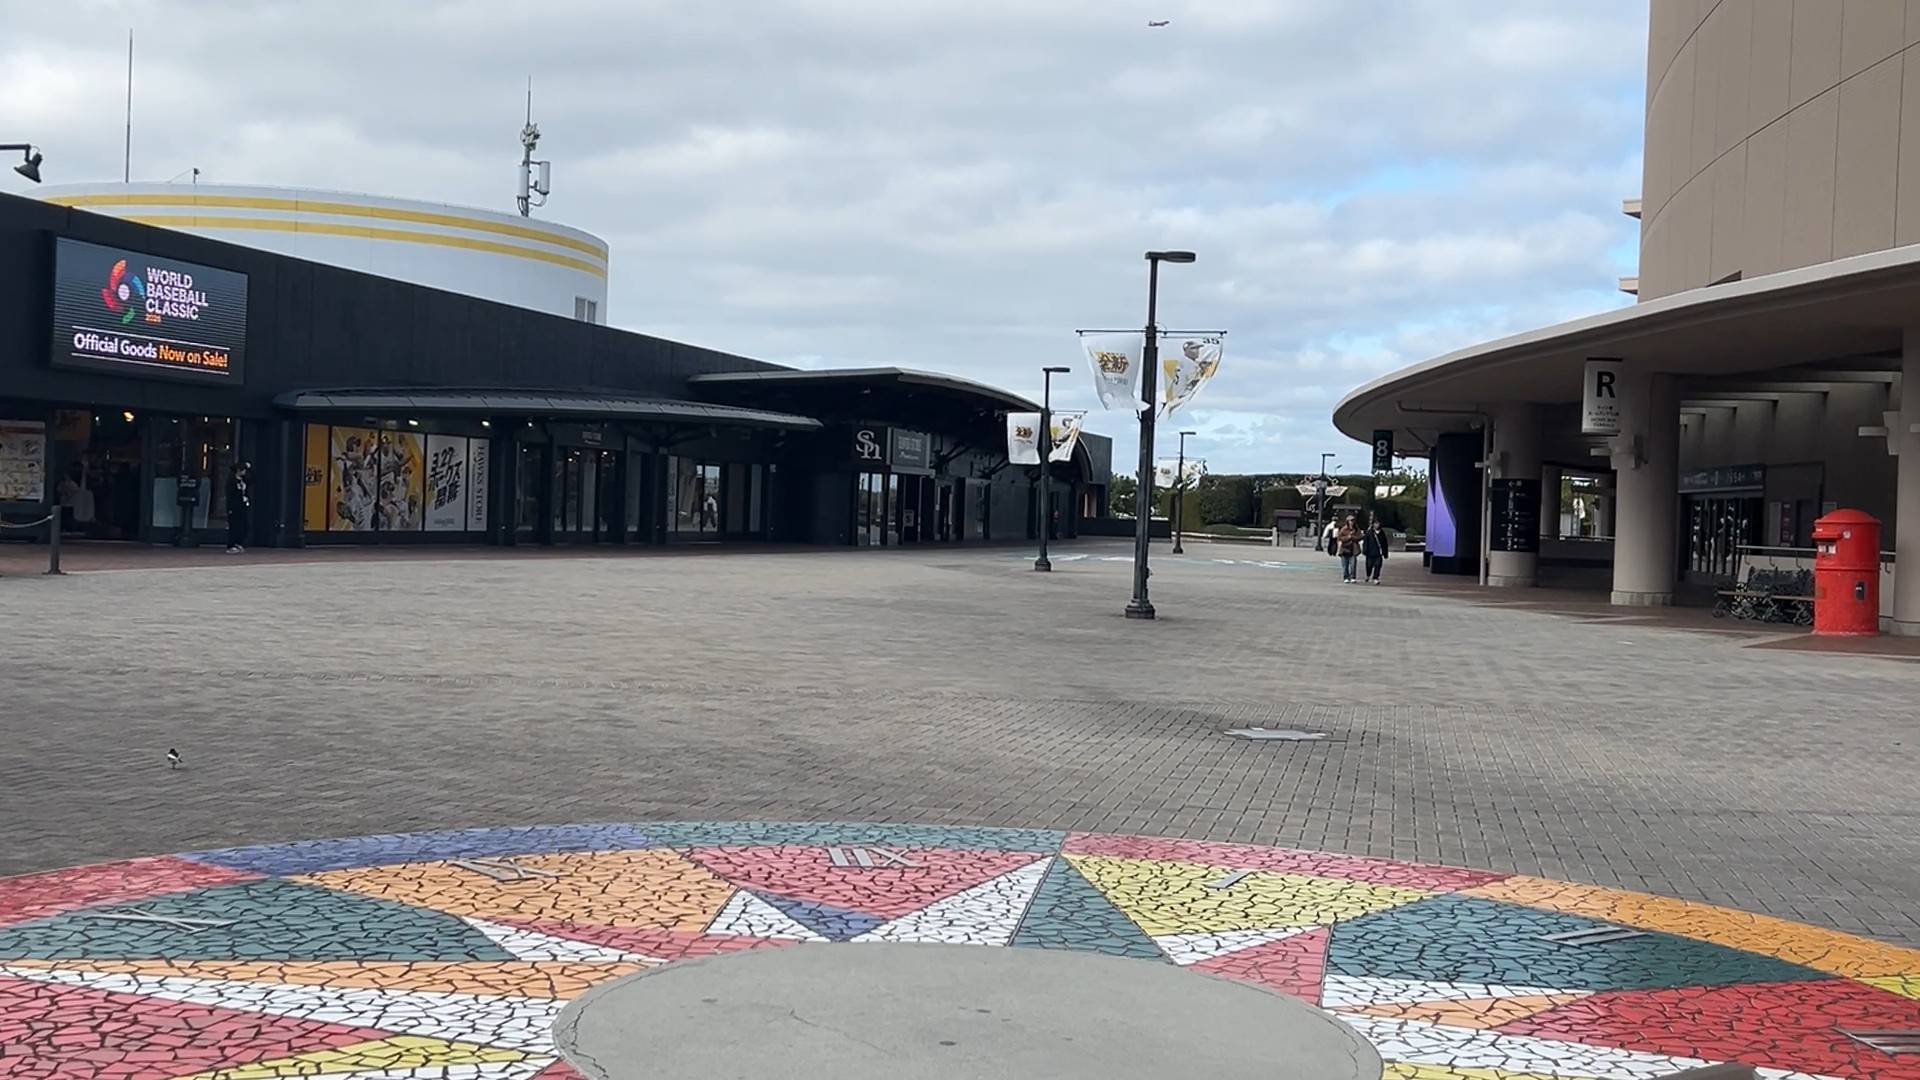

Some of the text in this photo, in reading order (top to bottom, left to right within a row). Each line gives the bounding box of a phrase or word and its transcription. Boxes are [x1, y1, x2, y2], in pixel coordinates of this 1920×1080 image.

[146, 267, 193, 288] WORLD
[145, 283, 209, 307] BASEBALL
[145, 299, 200, 321] CLASSIC
[73, 333, 228, 367] Official Goods Now on Sale!
[1596, 370, 1616, 398] R
[1376, 440, 1388, 457] 8
